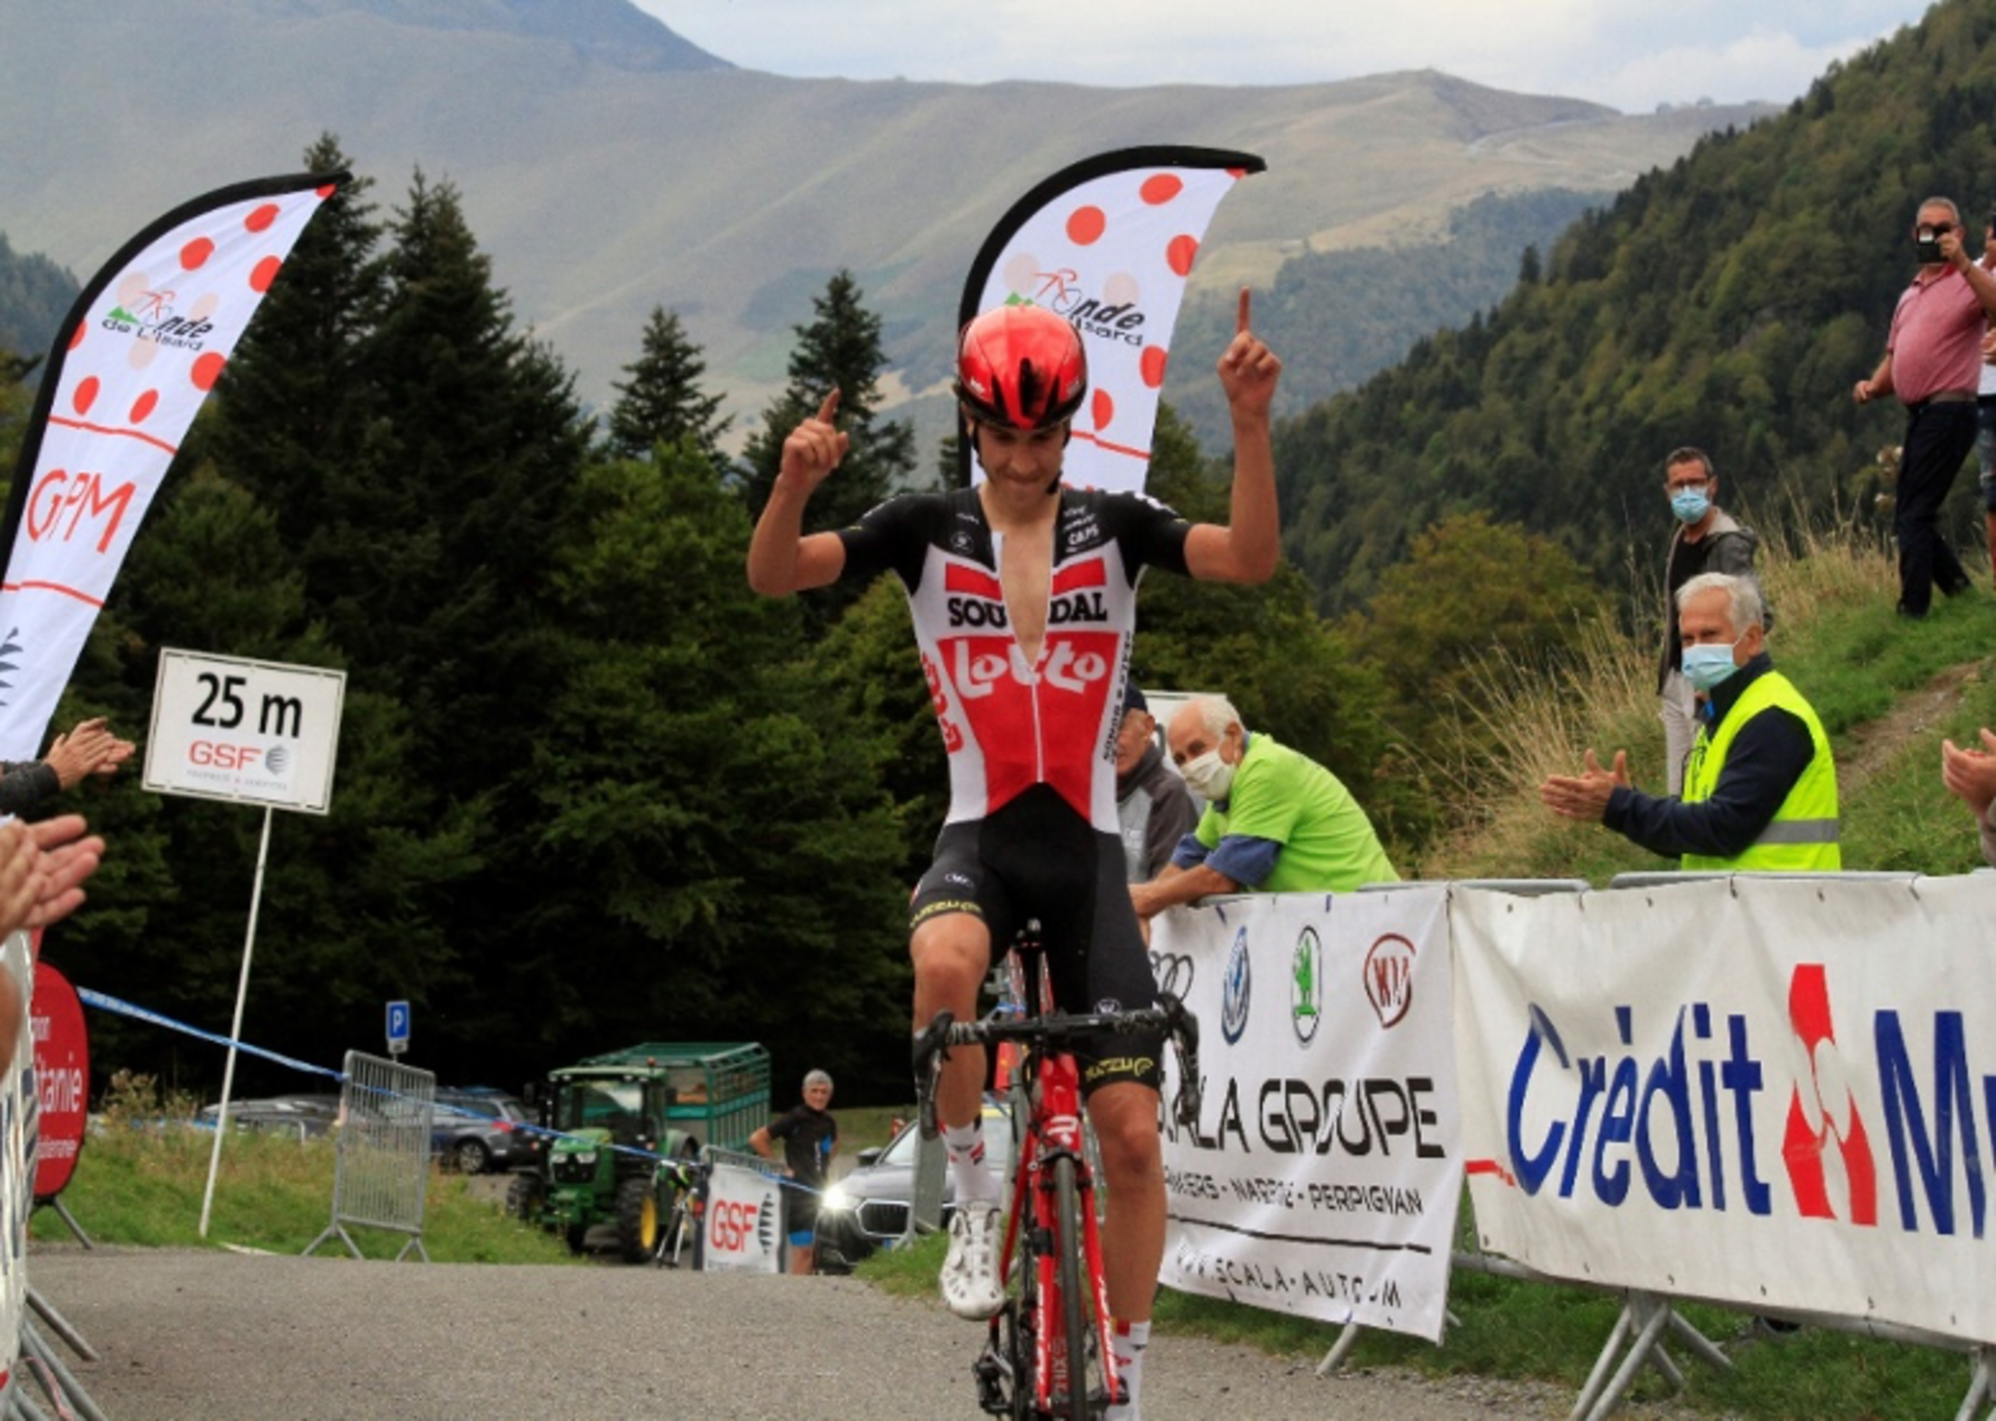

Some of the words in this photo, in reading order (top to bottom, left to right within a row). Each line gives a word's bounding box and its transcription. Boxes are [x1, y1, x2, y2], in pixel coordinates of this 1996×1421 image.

[27, 469, 136, 554] GPM
[191, 672, 246, 729] 25
[258, 693, 303, 739] m
[188, 740, 262, 770] GSF
[393, 1009, 404, 1034] P
[1259, 1078, 1446, 1158] GROUPE
[1506, 1003, 1772, 1215] Crédit
[1874, 1009, 1996, 1239] M
[711, 1199, 757, 1252] GSF
[1308, 1182, 1424, 1215] PERPIGNAN
